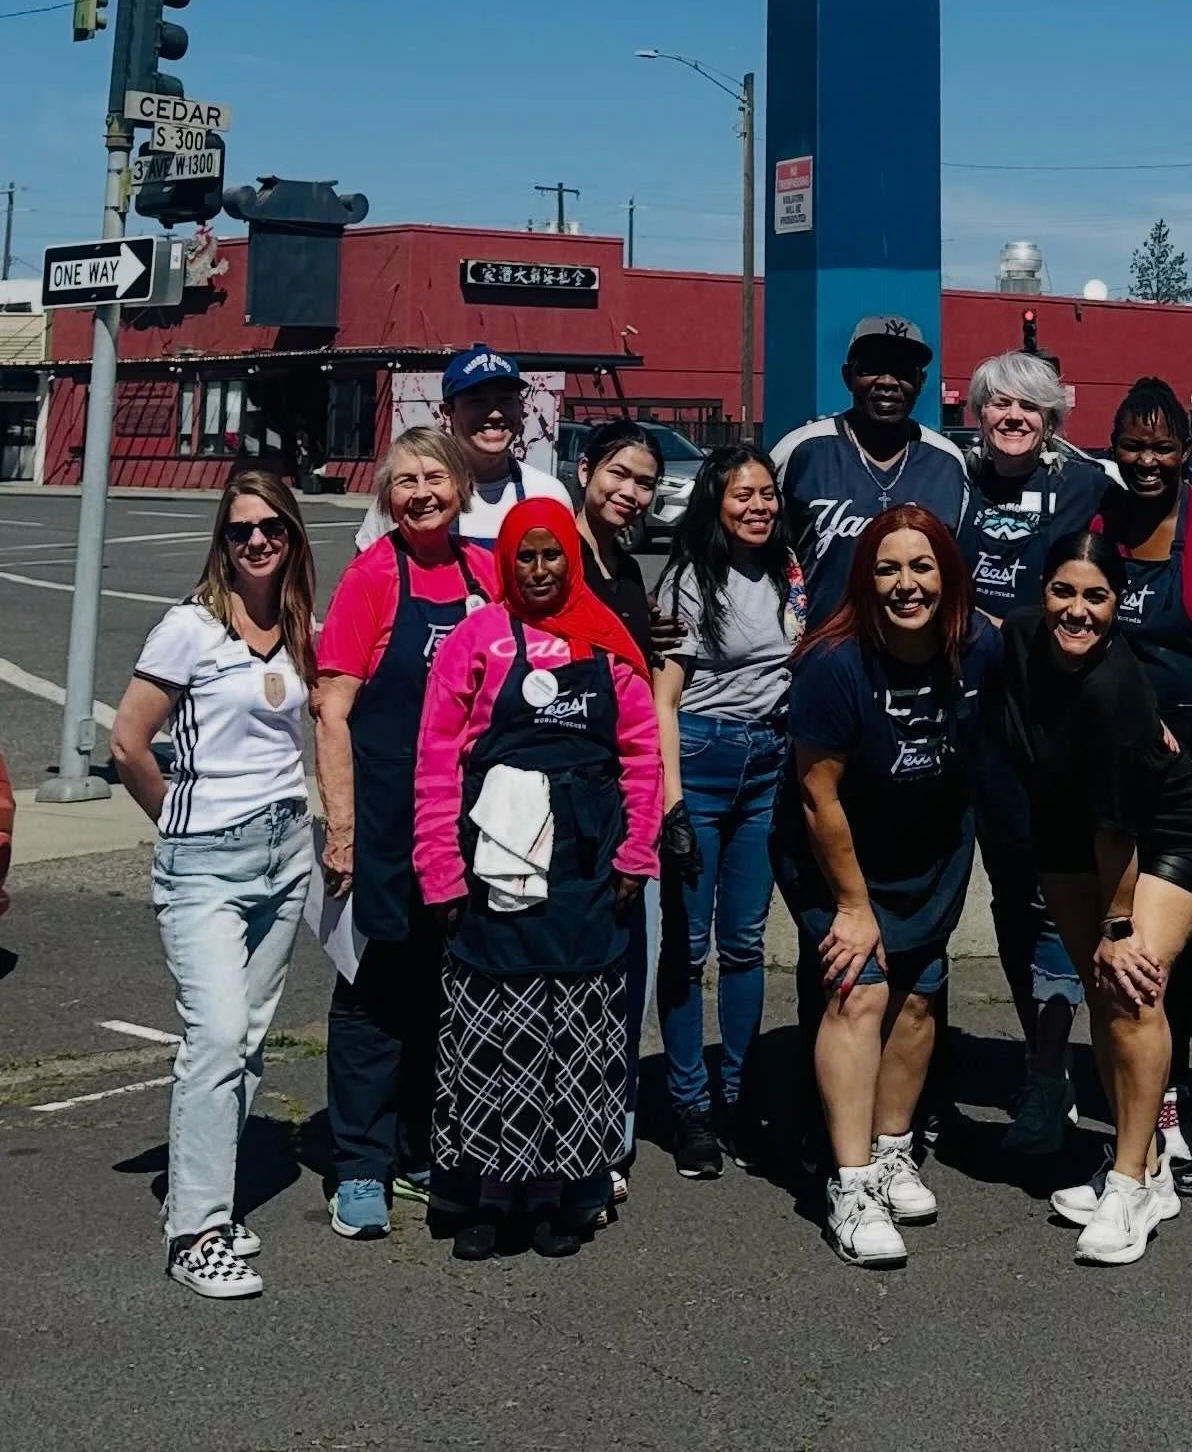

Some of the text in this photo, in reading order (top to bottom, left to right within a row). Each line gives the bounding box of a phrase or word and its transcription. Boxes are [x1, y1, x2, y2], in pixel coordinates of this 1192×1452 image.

[140, 97, 221, 127] CEDAR
[54, 260, 120, 287] ONE WAY
[972, 551, 1027, 589] Feast
[536, 690, 598, 718] east
